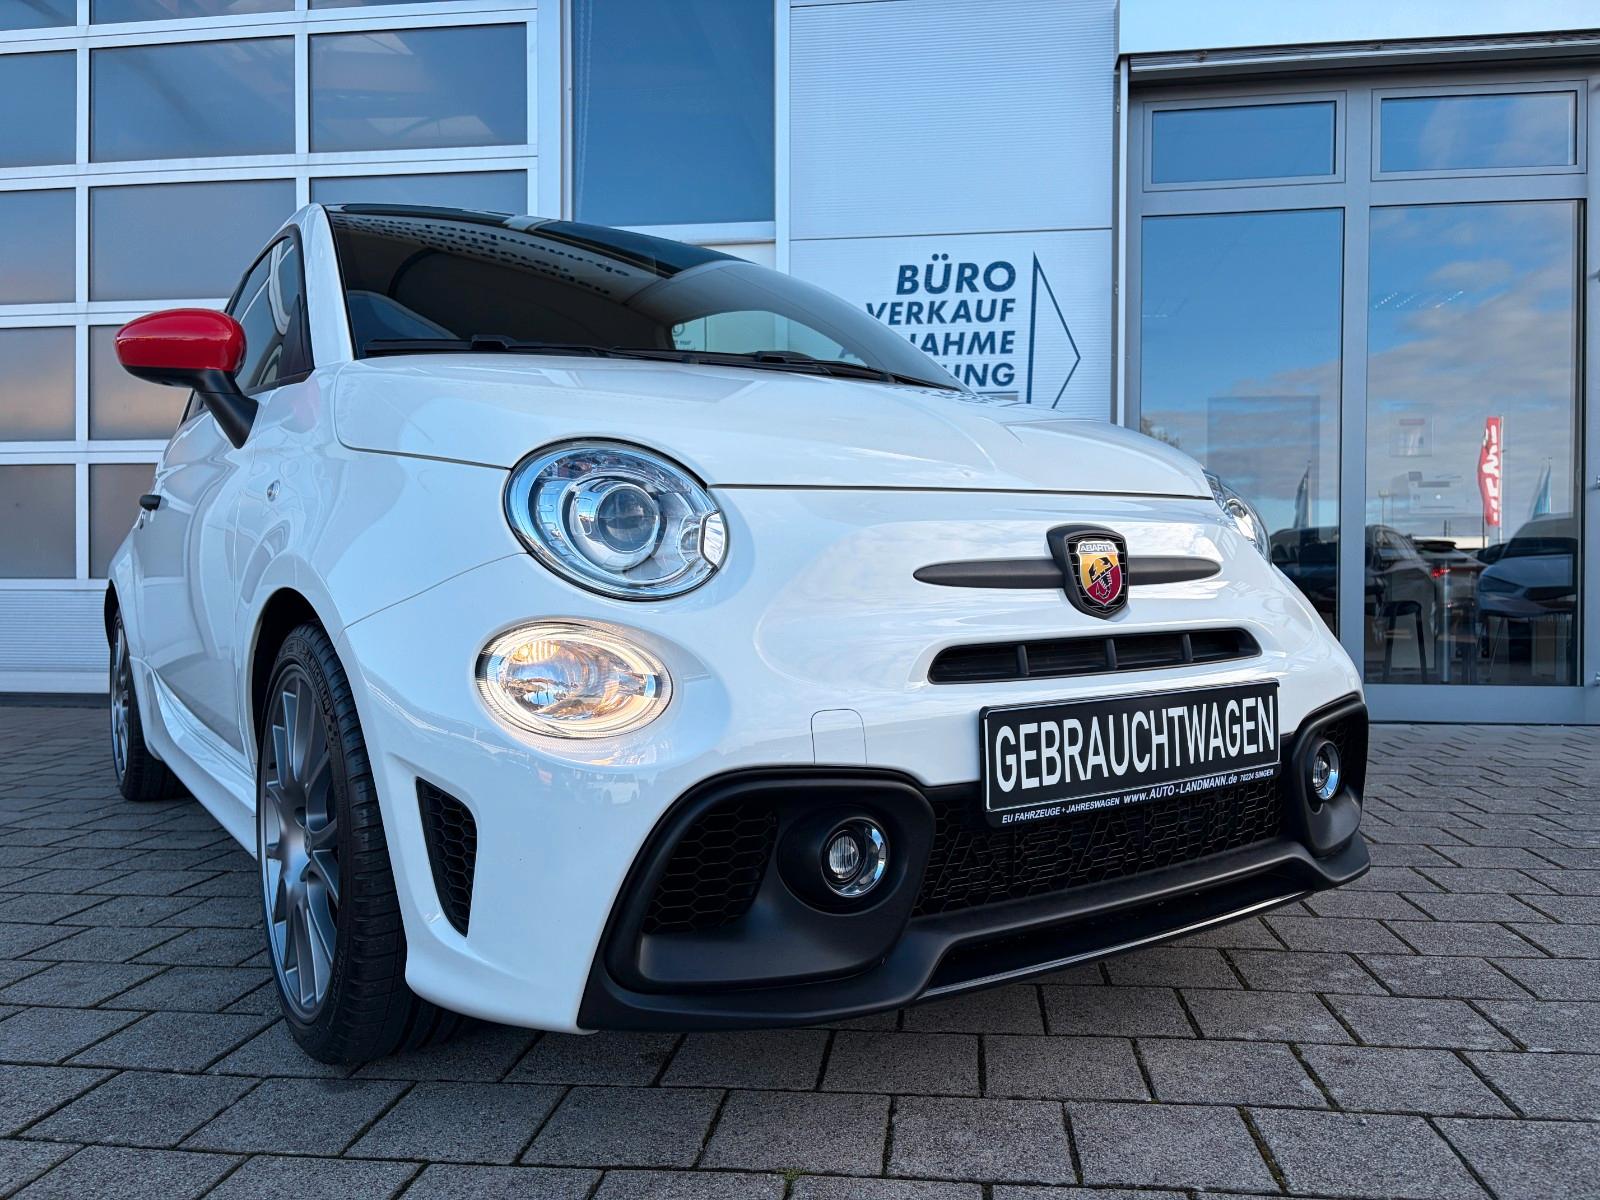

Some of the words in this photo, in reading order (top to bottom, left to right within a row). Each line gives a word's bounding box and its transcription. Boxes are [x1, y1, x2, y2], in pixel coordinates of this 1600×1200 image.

[896, 253, 1016, 295] BÜRO
[866, 298, 1016, 325] VERKAUF
[910, 330, 1016, 356] AHME
[1080, 543, 1114, 552] ABARTH
[995, 695, 1275, 793] GEBRAUCHTWAGEN
[1002, 814, 1014, 824] EU
[1015, 806, 1061, 822] FAHRZEUGE
[1066, 797, 1120, 814] JAHRESWAGEN
